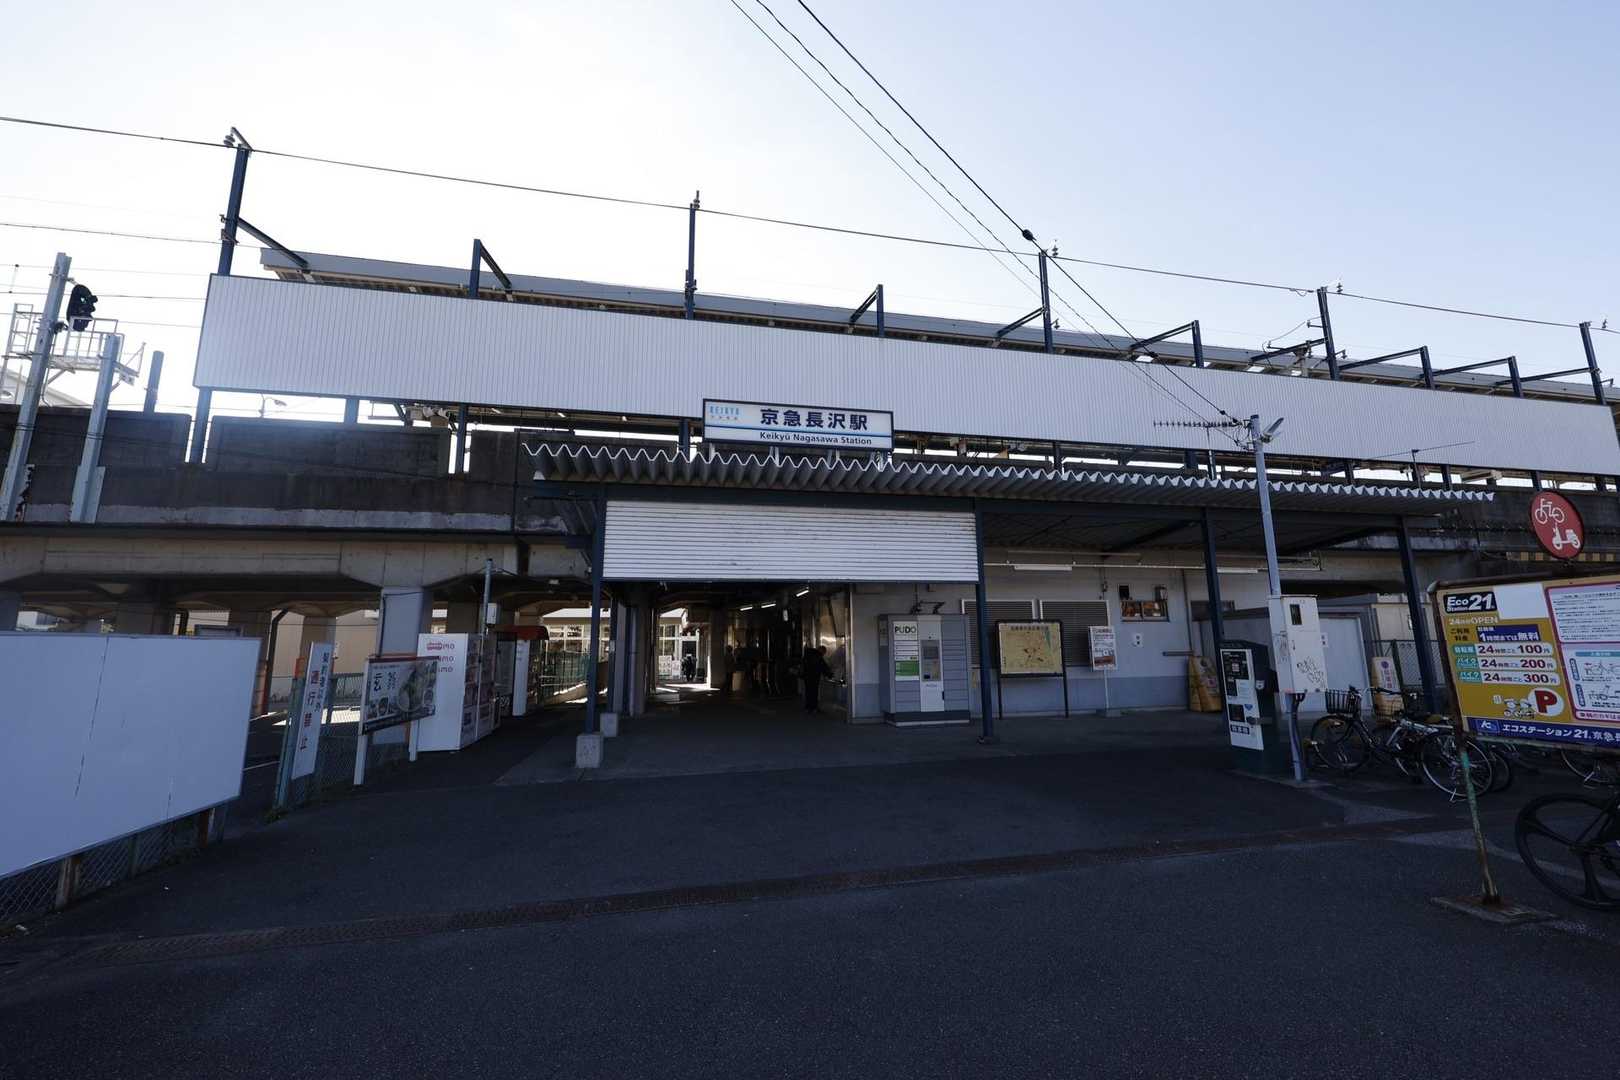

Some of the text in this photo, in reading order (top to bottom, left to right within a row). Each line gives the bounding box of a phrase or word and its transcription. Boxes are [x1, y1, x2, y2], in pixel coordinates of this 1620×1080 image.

[760, 408, 868, 431] 京急長沢駅
[793, 433, 839, 444] Nagasawa
[841, 436, 872, 446] Station
[1447, 593, 1493, 611] Eco 21
[894, 626, 917, 634] PUDO
[1534, 690, 1558, 713] P
[1502, 724, 1573, 737] エコステーション
